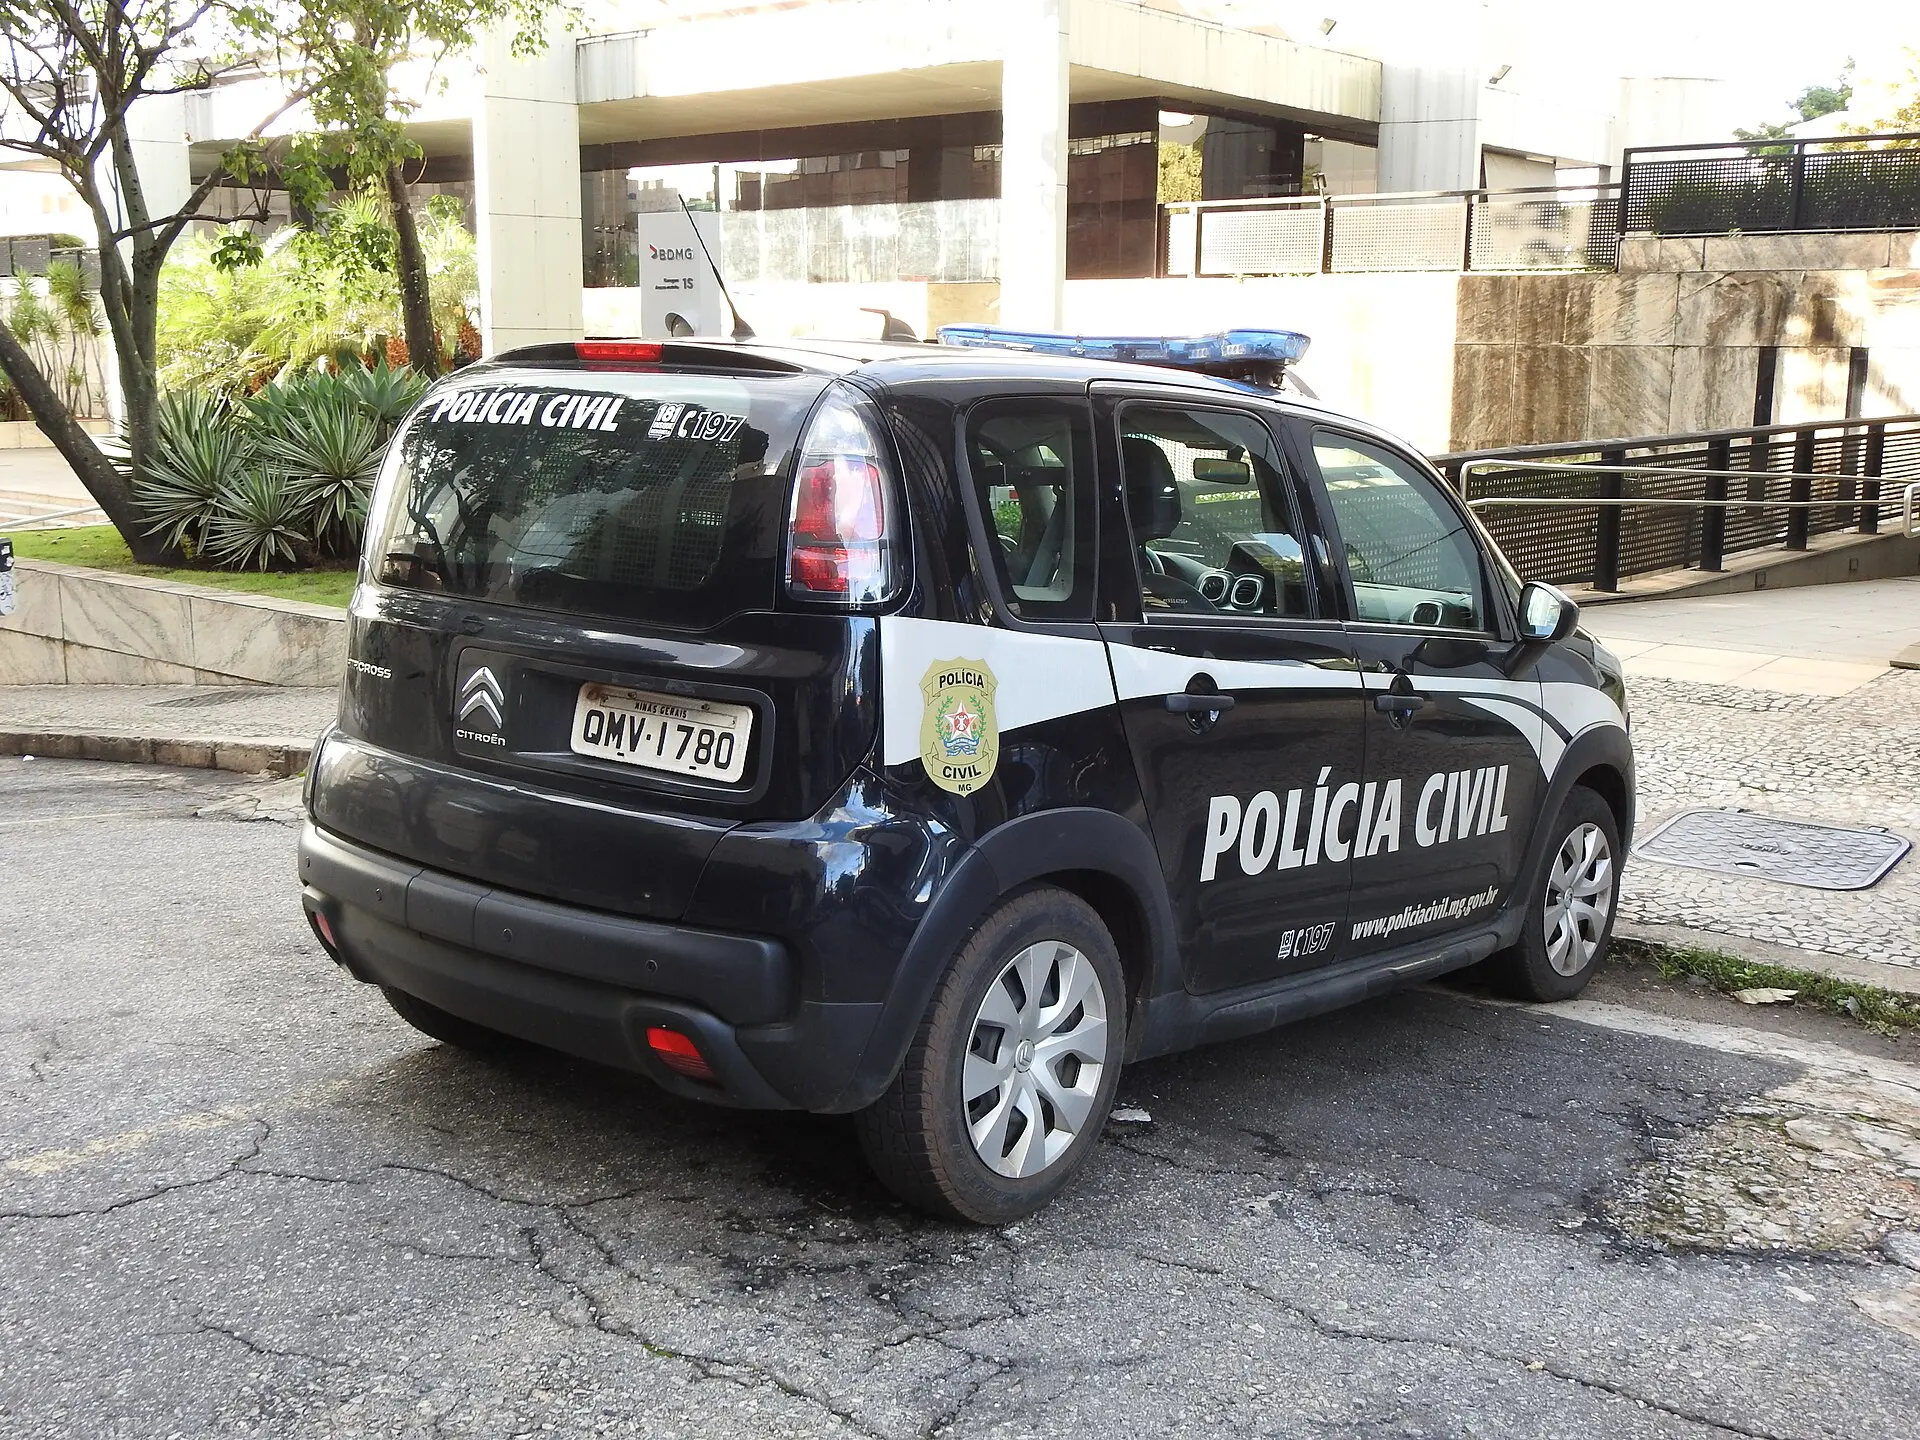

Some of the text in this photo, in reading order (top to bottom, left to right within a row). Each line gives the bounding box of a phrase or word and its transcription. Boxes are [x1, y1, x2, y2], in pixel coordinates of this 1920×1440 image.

[659, 248, 694, 261] BDMG
[430, 385, 625, 432] POLÍCIA CIVIL
[657, 404, 683, 423] 181
[691, 410, 748, 442] 197
[347, 658, 392, 679] CROSS
[939, 668, 985, 689] POLÍCIA
[634, 702, 688, 719] MINAS GERAIS
[942, 764, 982, 779] CIVIL
[958, 783, 972, 792] MG
[1200, 764, 1509, 882] POLÍCIA CIVIL
[1351, 885, 1499, 941] www.policiacivil.mg.gov.br
[1302, 921, 1336, 956] 197
